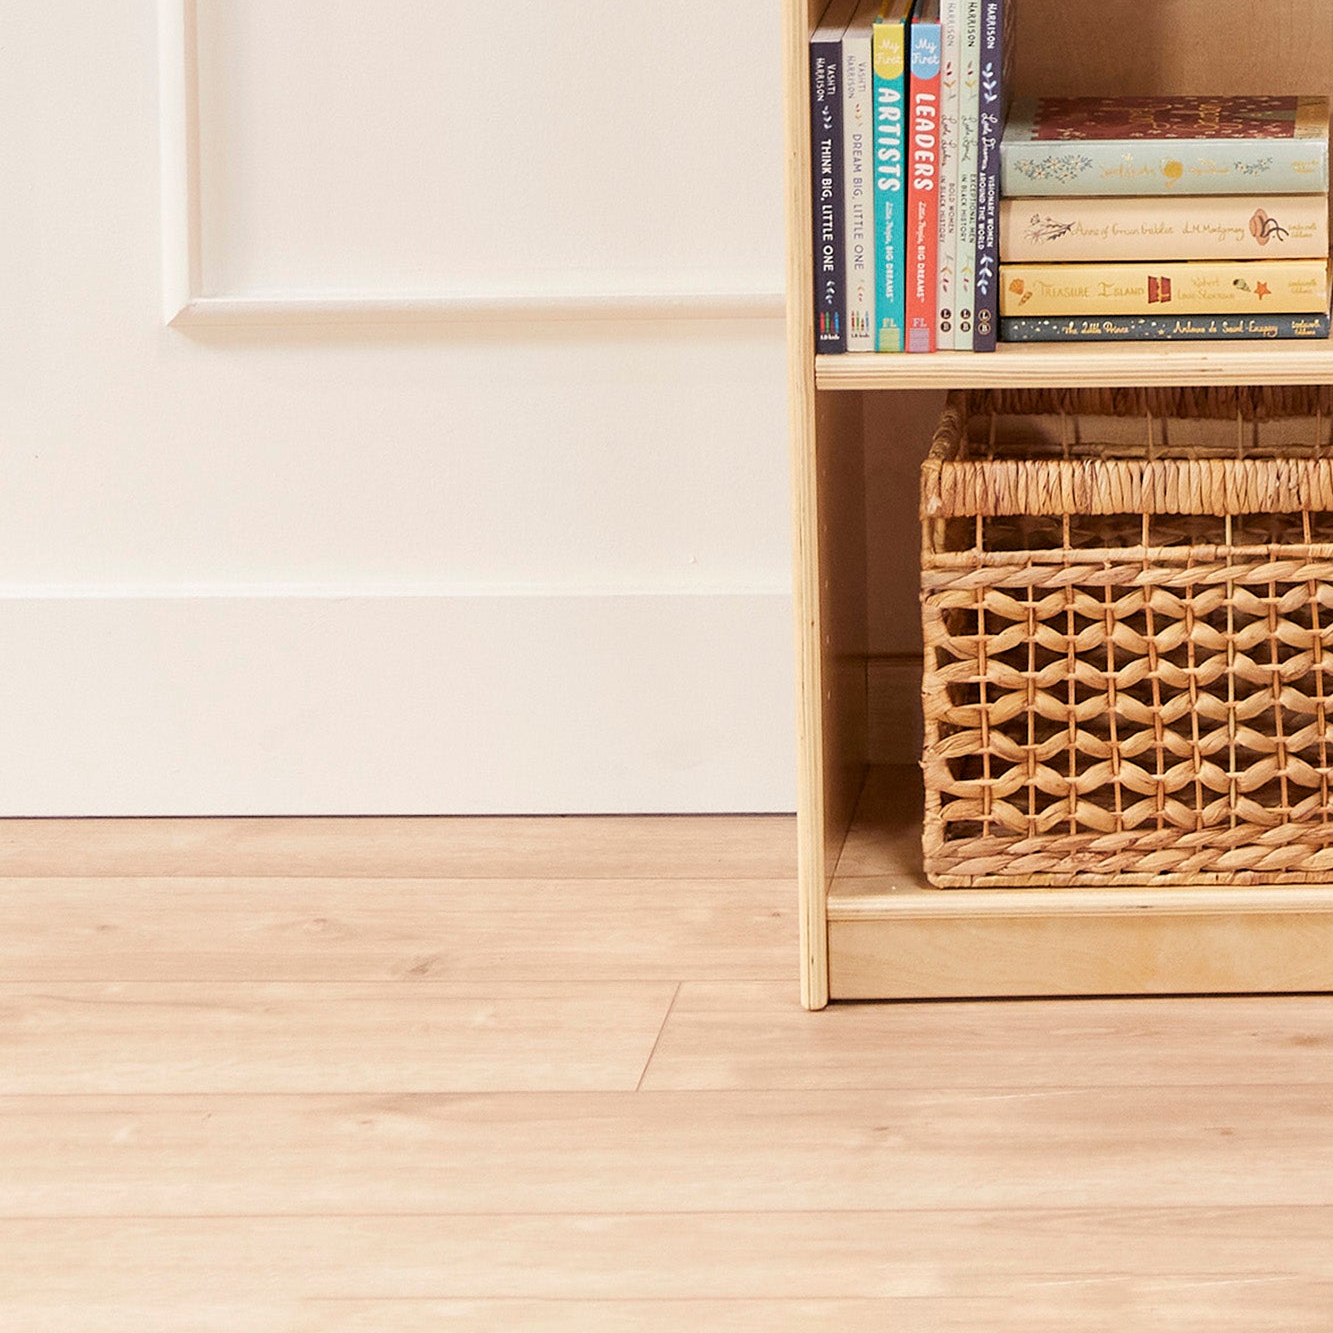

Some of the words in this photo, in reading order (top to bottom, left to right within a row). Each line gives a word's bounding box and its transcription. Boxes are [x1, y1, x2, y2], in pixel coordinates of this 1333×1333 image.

[985, 3, 997, 49] HARRISON
[915, 39, 936, 53] My
[815, 57, 825, 101] HARRISON
[826, 64, 836, 94] VASHTI
[852, 134, 862, 172] DREAM
[877, 87, 900, 190] ARTISTS
[913, 92, 935, 190] LEADERS
[821, 139, 831, 174] THINK
[820, 178, 832, 200] BIG,
[851, 177, 862, 199] BIG,
[978, 172, 986, 202] AROUND
[822, 204, 832, 240] LITTLE
[853, 204, 862, 238] LITTLE
[822, 245, 833, 271] ONE
[853, 244, 863, 270] ONE
[1038, 281, 1088, 297] TREASURE
[1099, 282, 1144, 297] ISLAND
